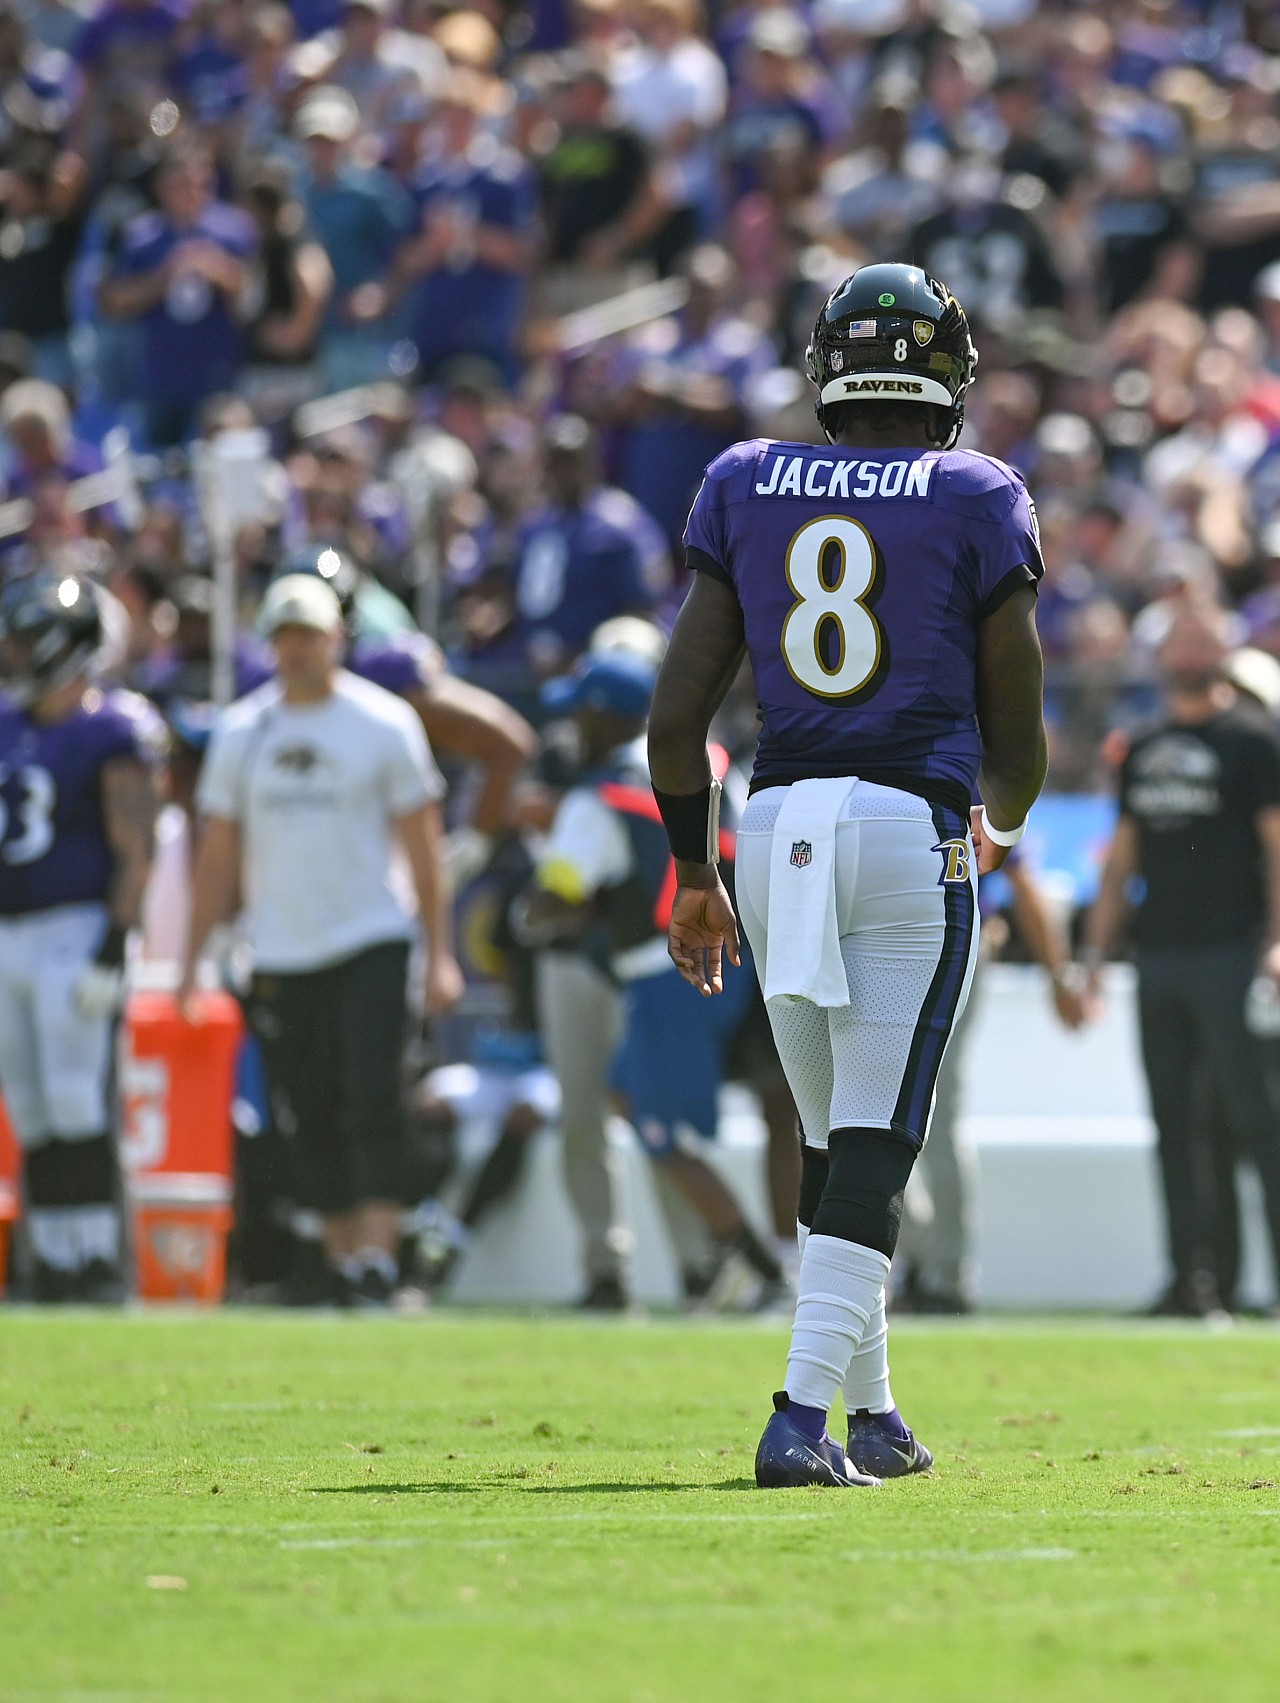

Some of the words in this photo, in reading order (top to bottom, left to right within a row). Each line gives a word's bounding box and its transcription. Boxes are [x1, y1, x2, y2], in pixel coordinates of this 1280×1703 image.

[894, 338, 908, 362] 8
[843, 379, 923, 394] RAVENS
[755, 455, 935, 498] JACKSON
[780, 514, 883, 699] 8
[0, 763, 55, 864] 3
[792, 852, 810, 866] NFL
